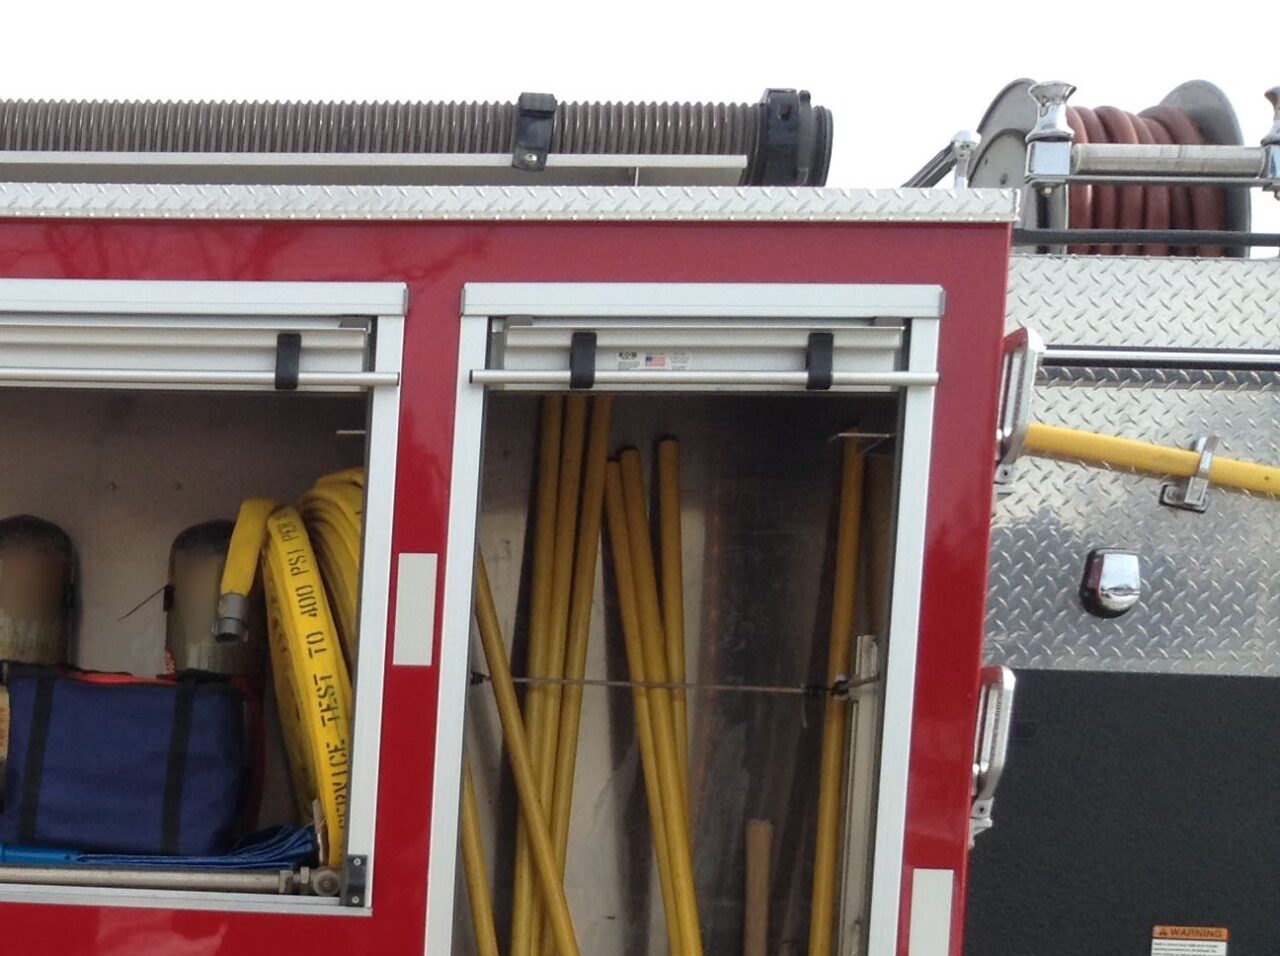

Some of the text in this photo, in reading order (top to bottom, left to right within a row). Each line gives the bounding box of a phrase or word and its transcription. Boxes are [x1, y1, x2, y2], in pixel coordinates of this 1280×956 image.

[286, 548, 310, 577] PSI
[295, 584, 319, 618] 400
[306, 630, 328, 659] TO
[313, 673, 340, 728] TEST
[1170, 927, 1222, 938] WARNING
